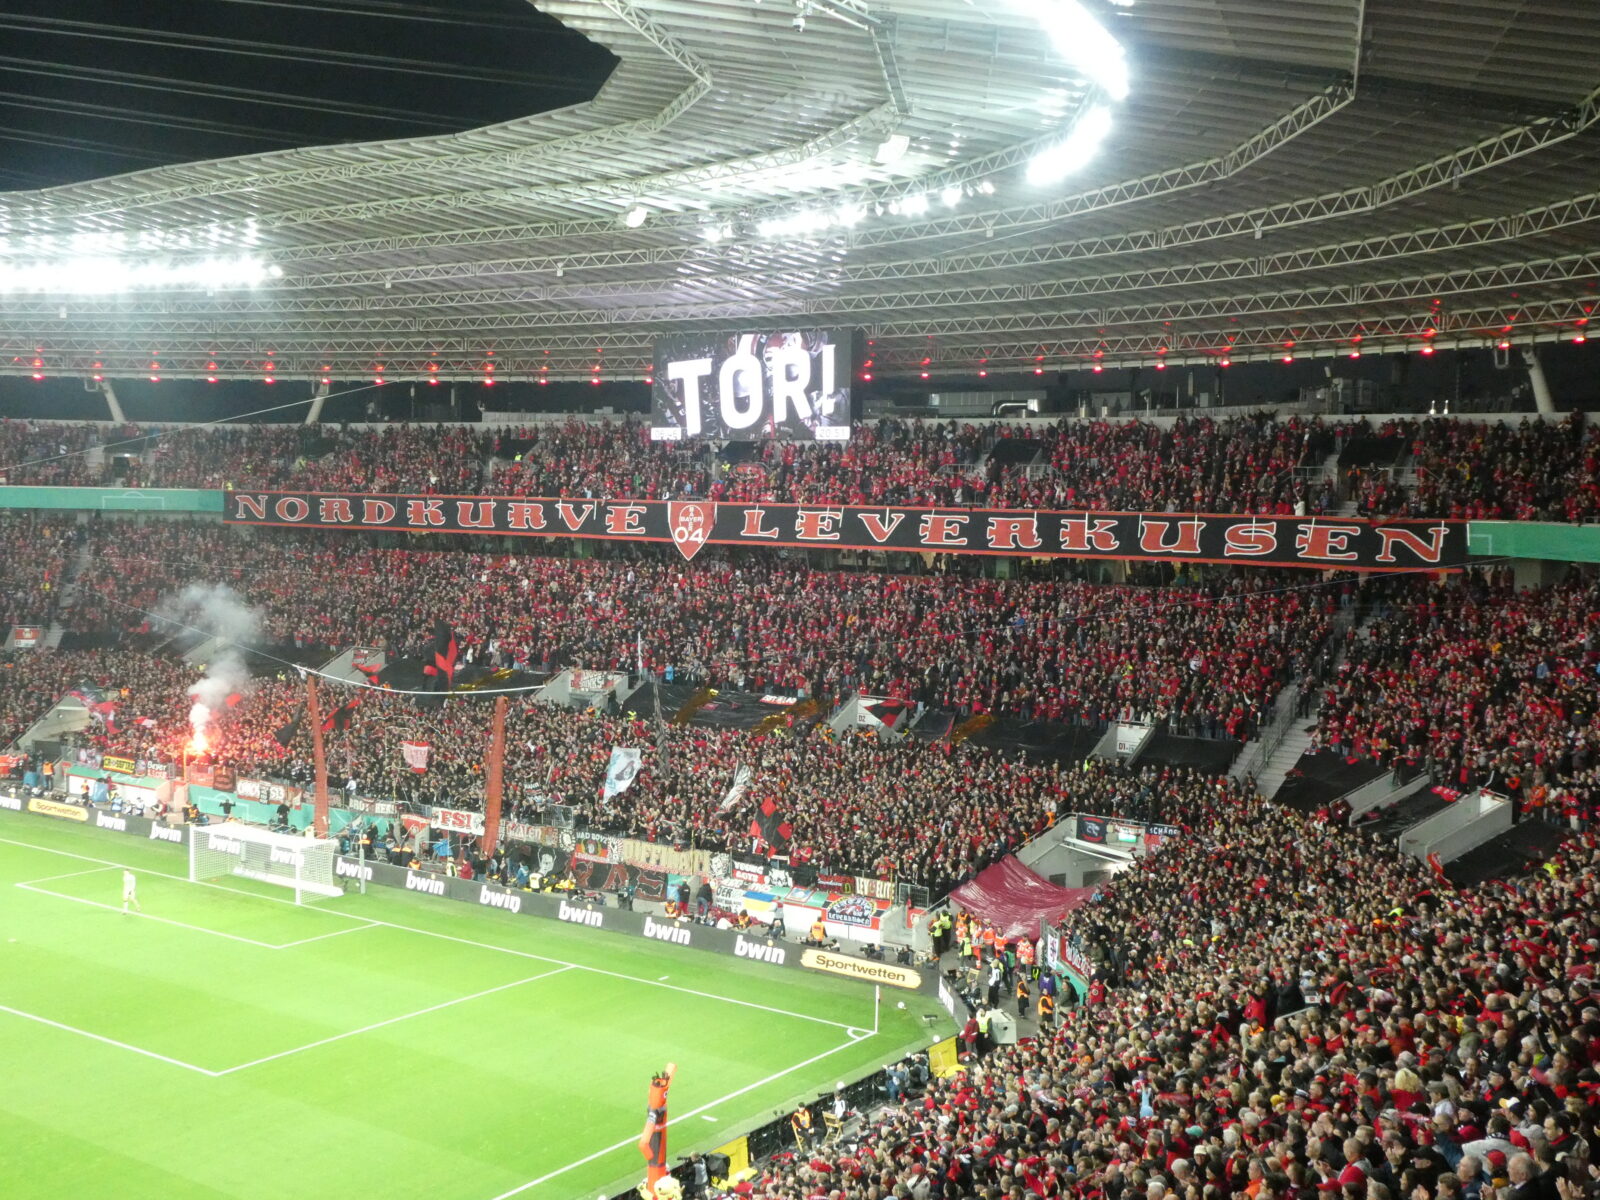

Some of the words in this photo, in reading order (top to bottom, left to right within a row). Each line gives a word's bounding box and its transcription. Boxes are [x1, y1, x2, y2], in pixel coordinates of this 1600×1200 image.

[667, 343, 836, 436] TOR!
[235, 495, 647, 535] NORDKURVE
[740, 509, 1449, 562] LEVERKUSEN
[674, 526, 705, 544] 04
[35, 801, 81, 817] Sportwetten
[96, 810, 126, 831] bwin
[336, 857, 373, 881] bwin
[405, 870, 445, 896] bwin
[479, 885, 521, 913] bwin
[558, 901, 603, 928] bwin
[643, 917, 691, 946] bwin
[734, 935, 786, 965] bwin
[815, 954, 906, 983] Sportwetten
